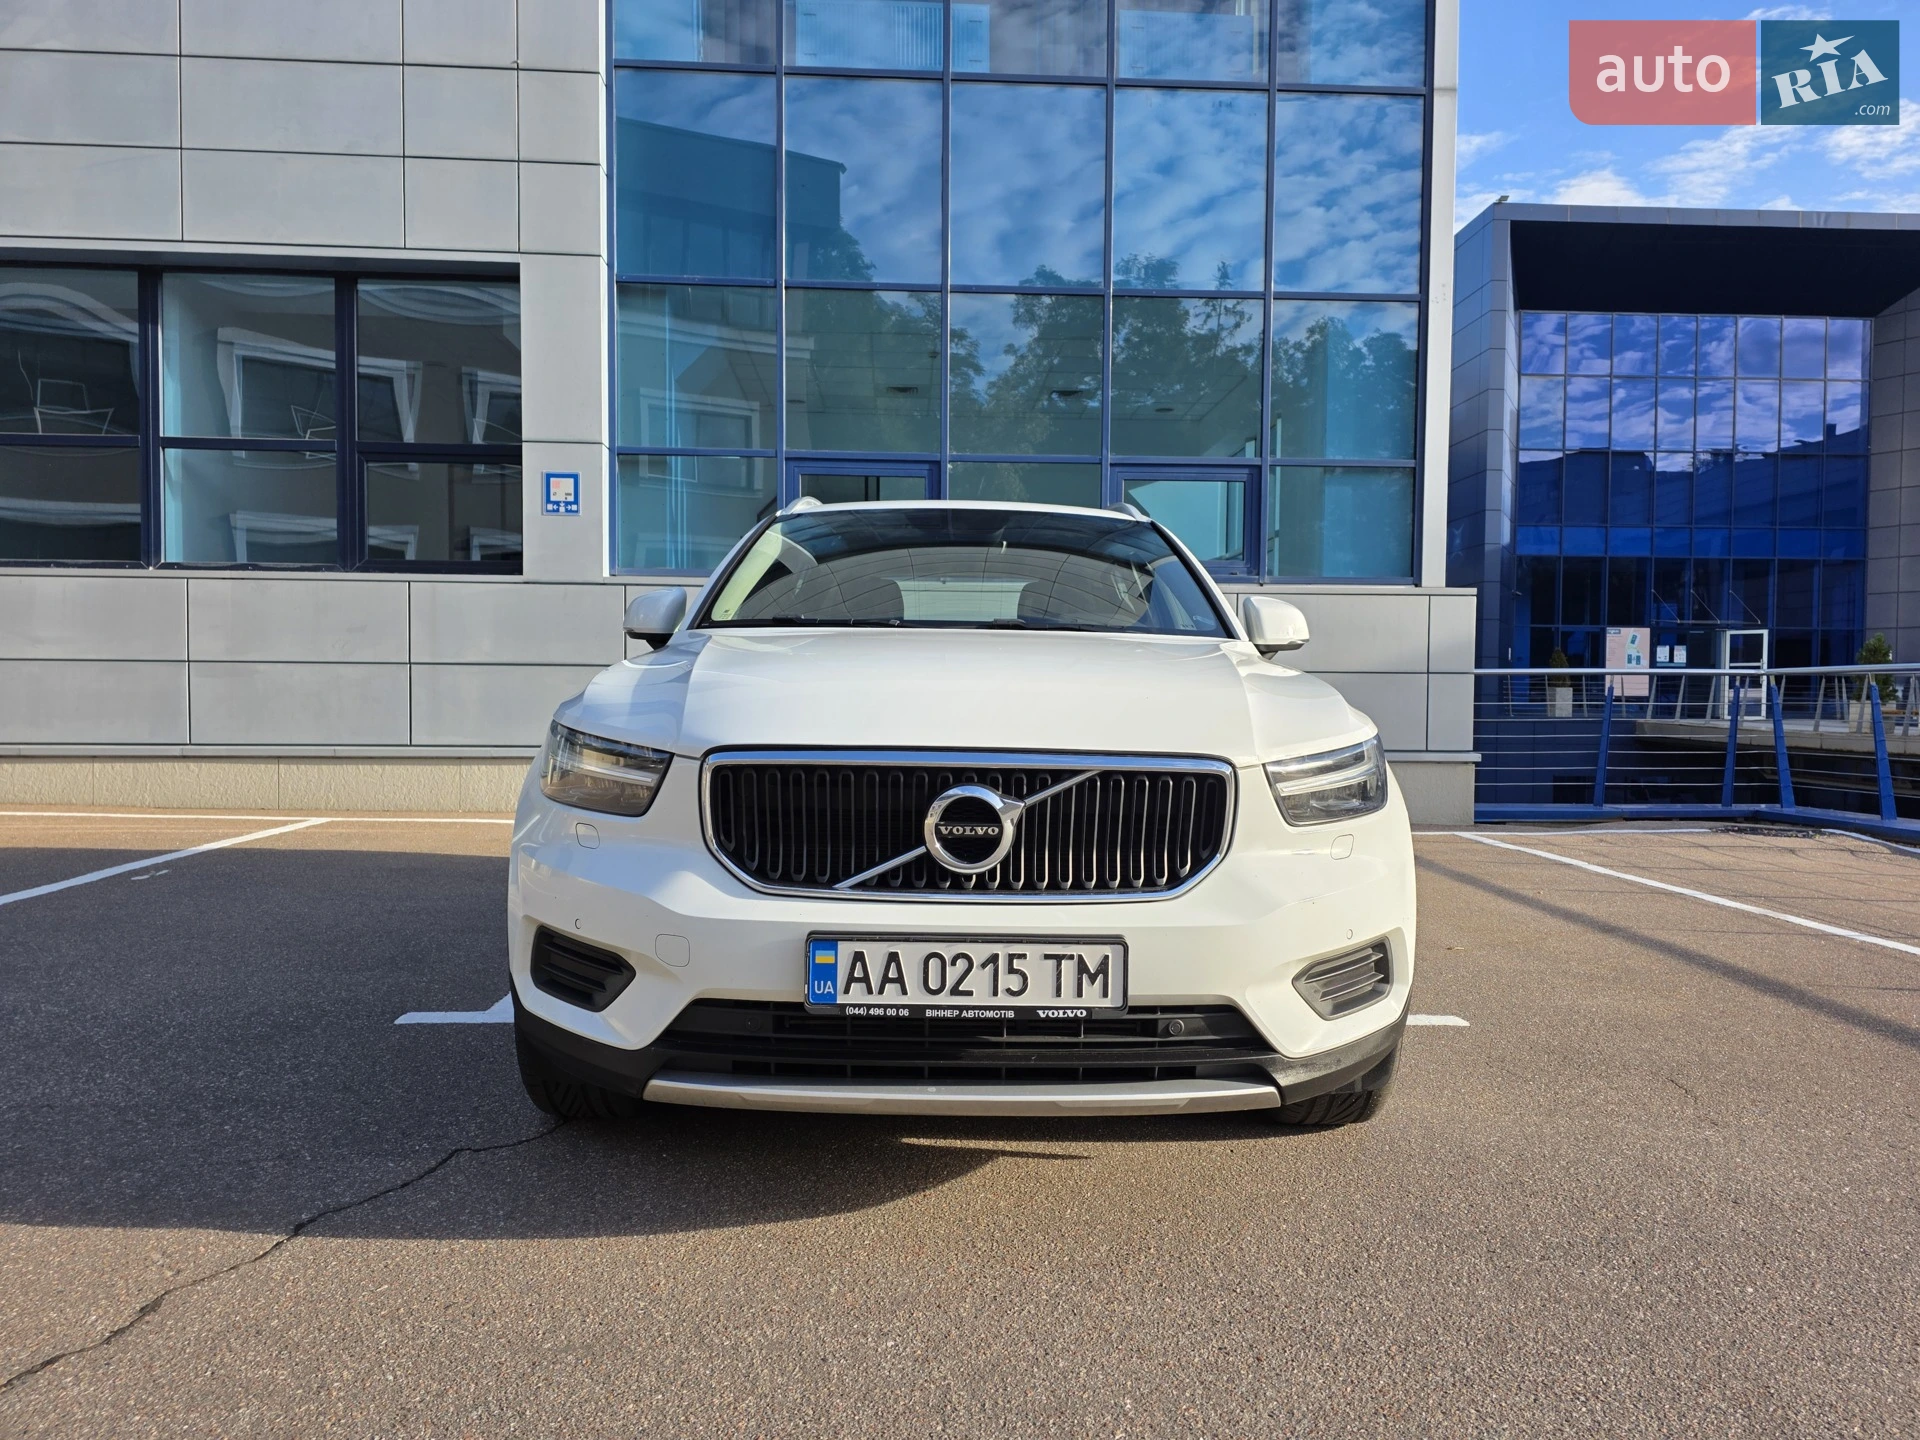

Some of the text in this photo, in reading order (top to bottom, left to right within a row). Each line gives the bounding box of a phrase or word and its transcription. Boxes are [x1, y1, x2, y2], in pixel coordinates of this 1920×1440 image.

[939, 826, 999, 835] VOLVO
[843, 950, 1112, 999] AA 0215 TM
[814, 980, 835, 995] UA
[845, 1006, 910, 1017] (044) 496 00 06
[925, 1009, 1015, 1018] ВІННЕР АВТОМОТІВ
[1036, 1009, 1087, 1018] VOLVO
